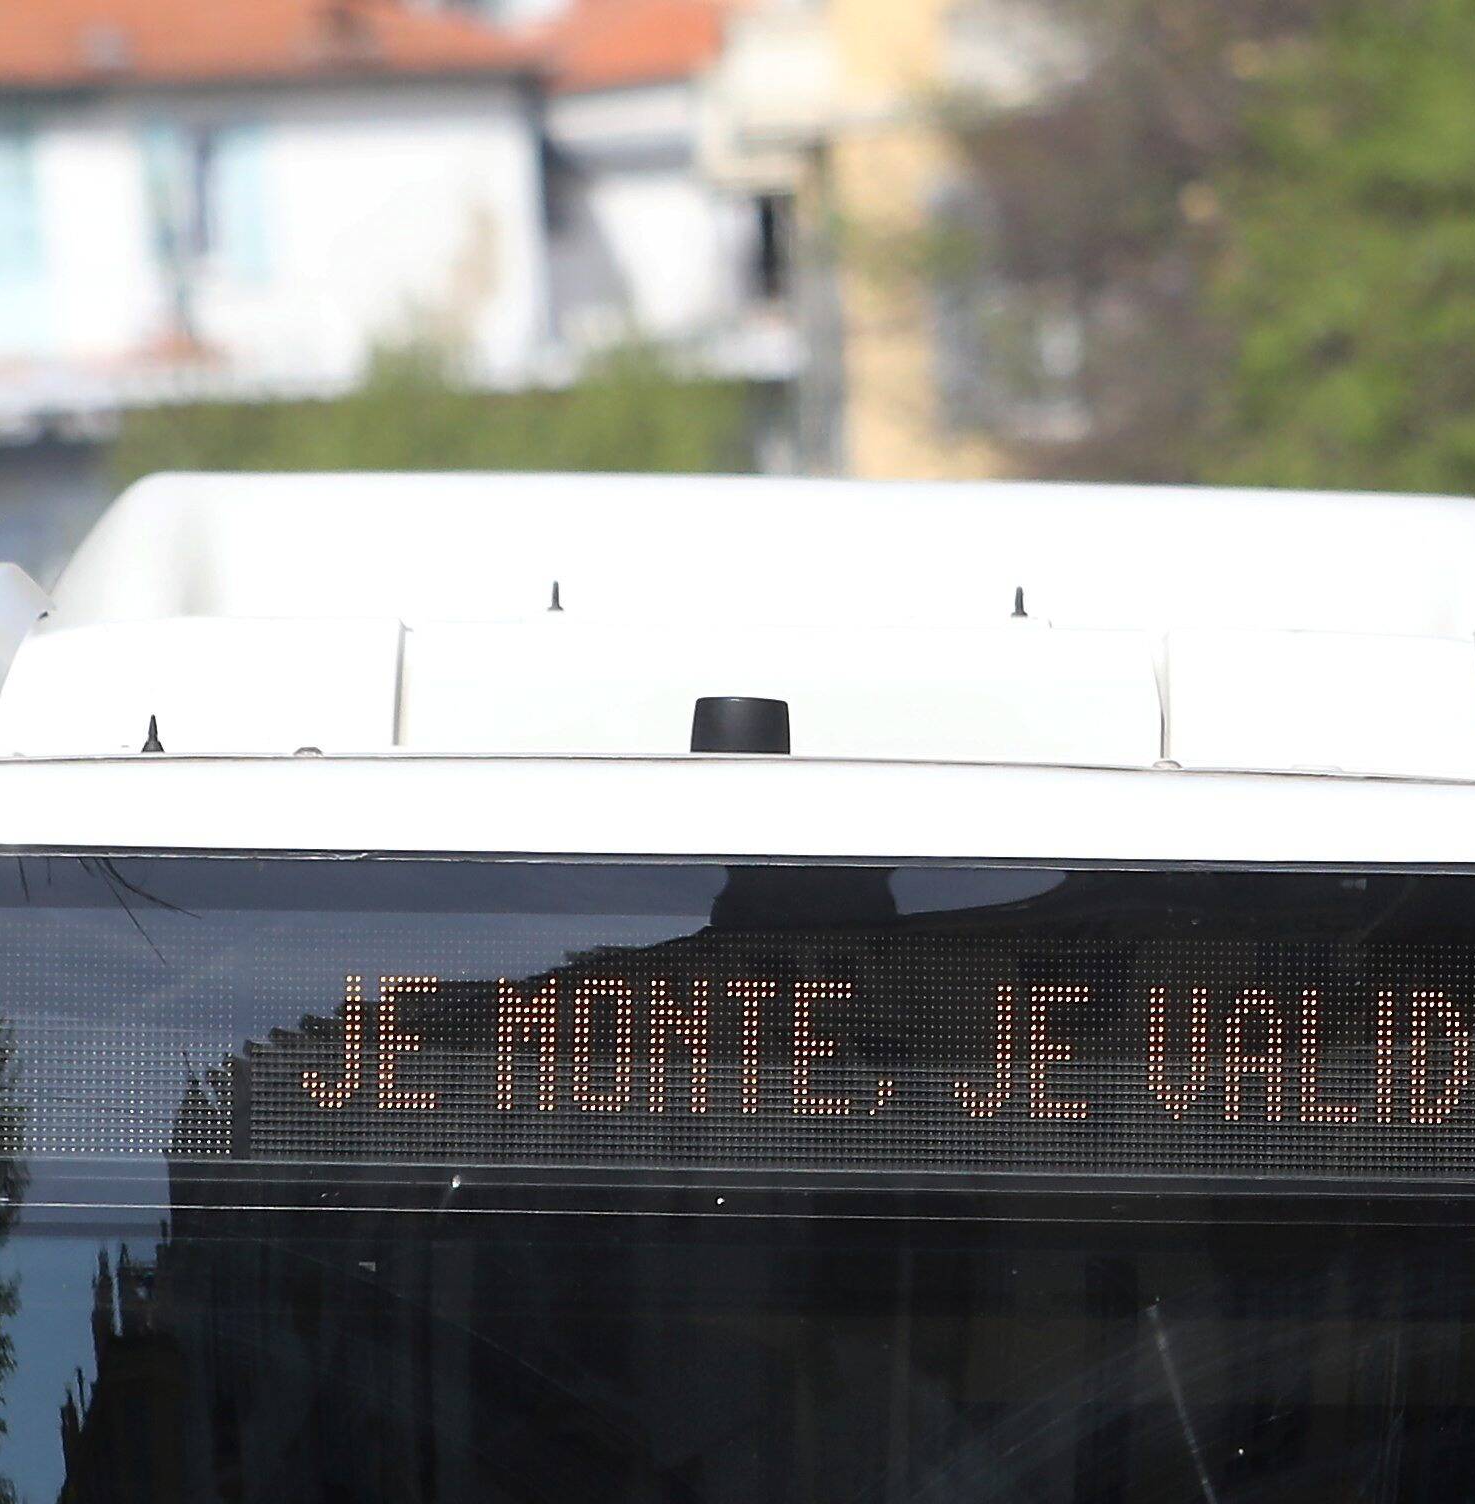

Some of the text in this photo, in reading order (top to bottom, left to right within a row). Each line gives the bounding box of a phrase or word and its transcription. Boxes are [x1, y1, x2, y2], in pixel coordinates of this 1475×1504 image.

[301, 974, 439, 1110] JE
[496, 976, 894, 1116] MONTE,
[953, 984, 1090, 1119] JE
